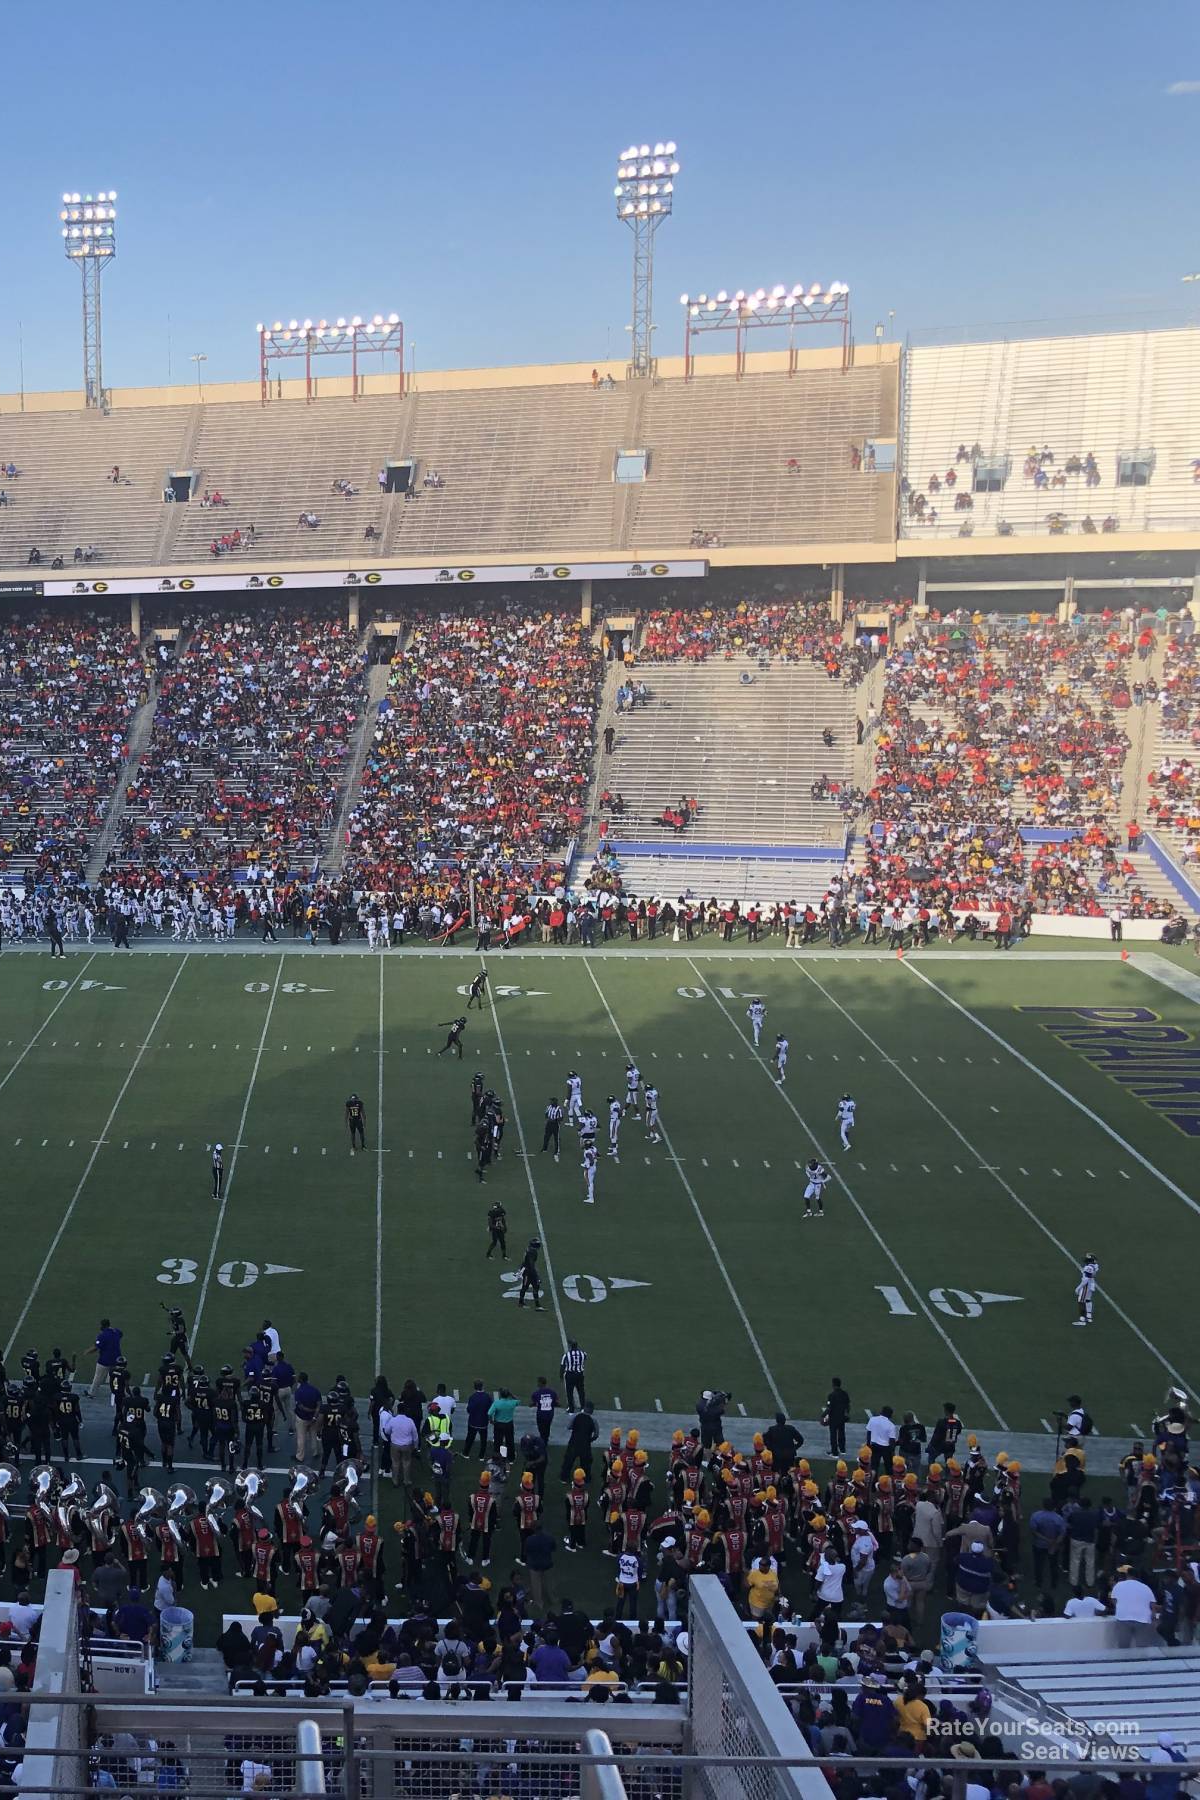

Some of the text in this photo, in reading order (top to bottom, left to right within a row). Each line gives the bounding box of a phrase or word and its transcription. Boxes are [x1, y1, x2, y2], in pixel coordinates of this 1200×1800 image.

[244, 982, 308, 993] 30
[676, 987, 740, 998] 10
[156, 1258, 259, 1288] 30
[874, 1285, 983, 1318] 10
[159, 1402, 171, 1418] 41
